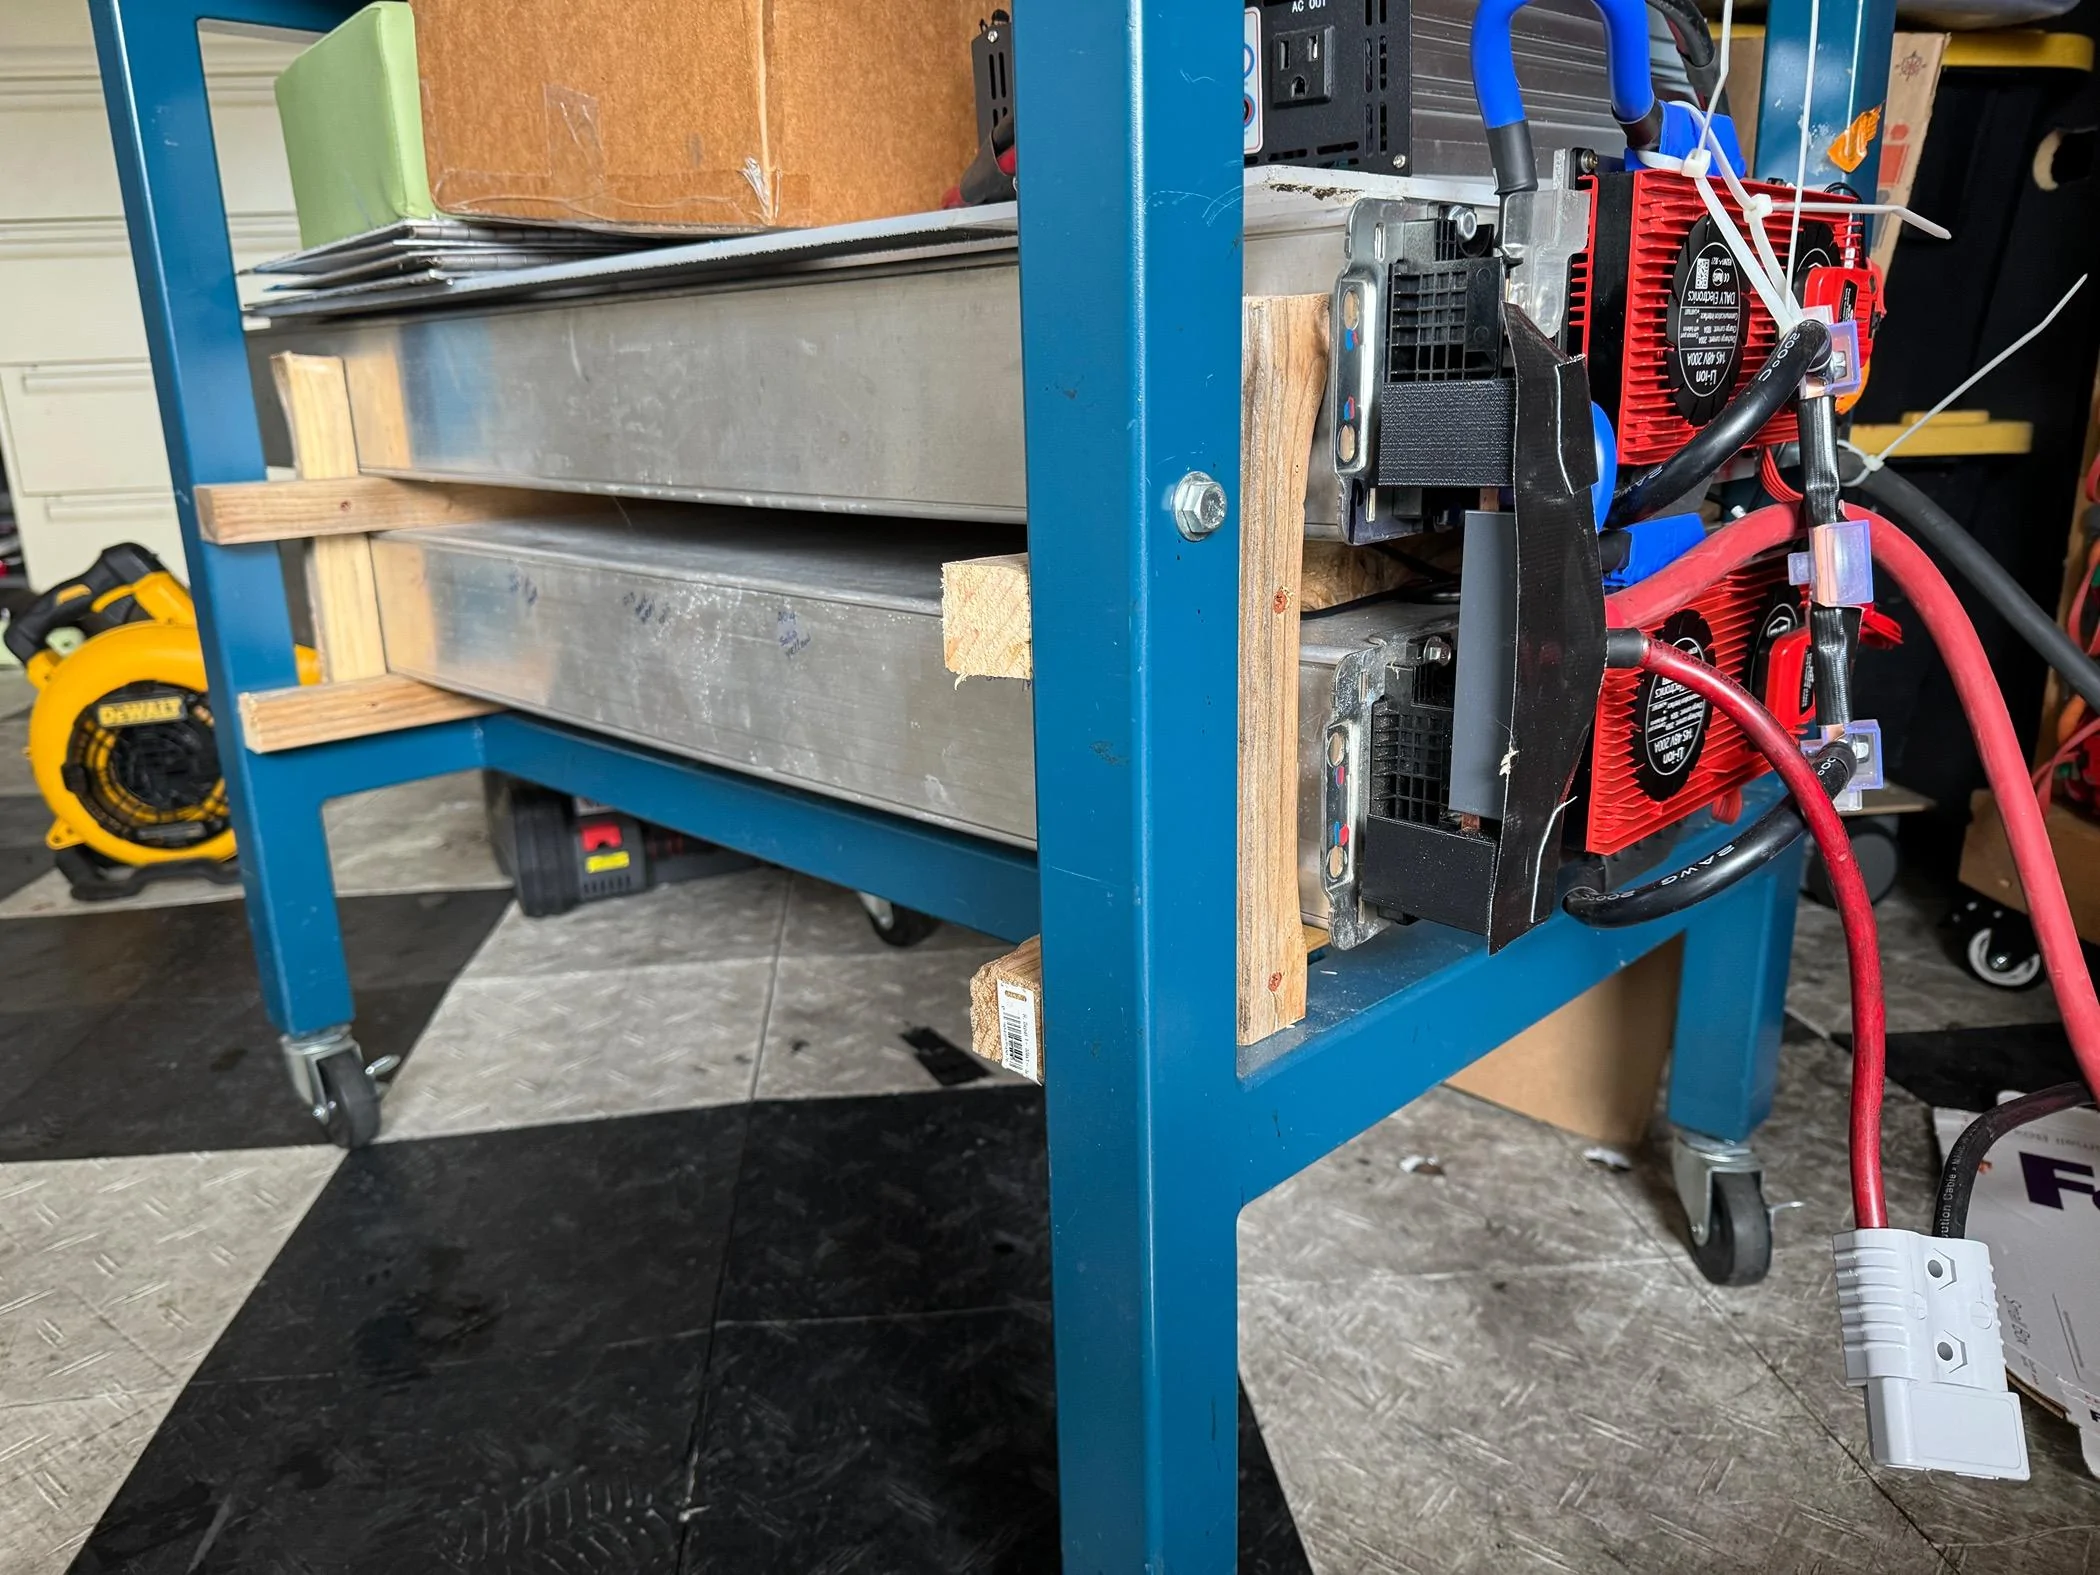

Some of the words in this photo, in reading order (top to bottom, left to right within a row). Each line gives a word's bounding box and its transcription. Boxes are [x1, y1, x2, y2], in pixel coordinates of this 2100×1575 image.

[1292, 1, 1304, 13] AC
[1309, 0, 1326, 10] OUT
[1687, 290, 1719, 305] Electronics
[1719, 291, 1736, 305] DALY
[1687, 352, 1704, 366] 200A
[1703, 351, 1716, 365] 48V
[1715, 351, 1726, 365] 14S
[1695, 369, 1717, 386] Li-ion
[1662, 746, 1686, 765] Li-ion
[1943, 1173, 1957, 1201] Cable
[2019, 1151, 2100, 1212] F
